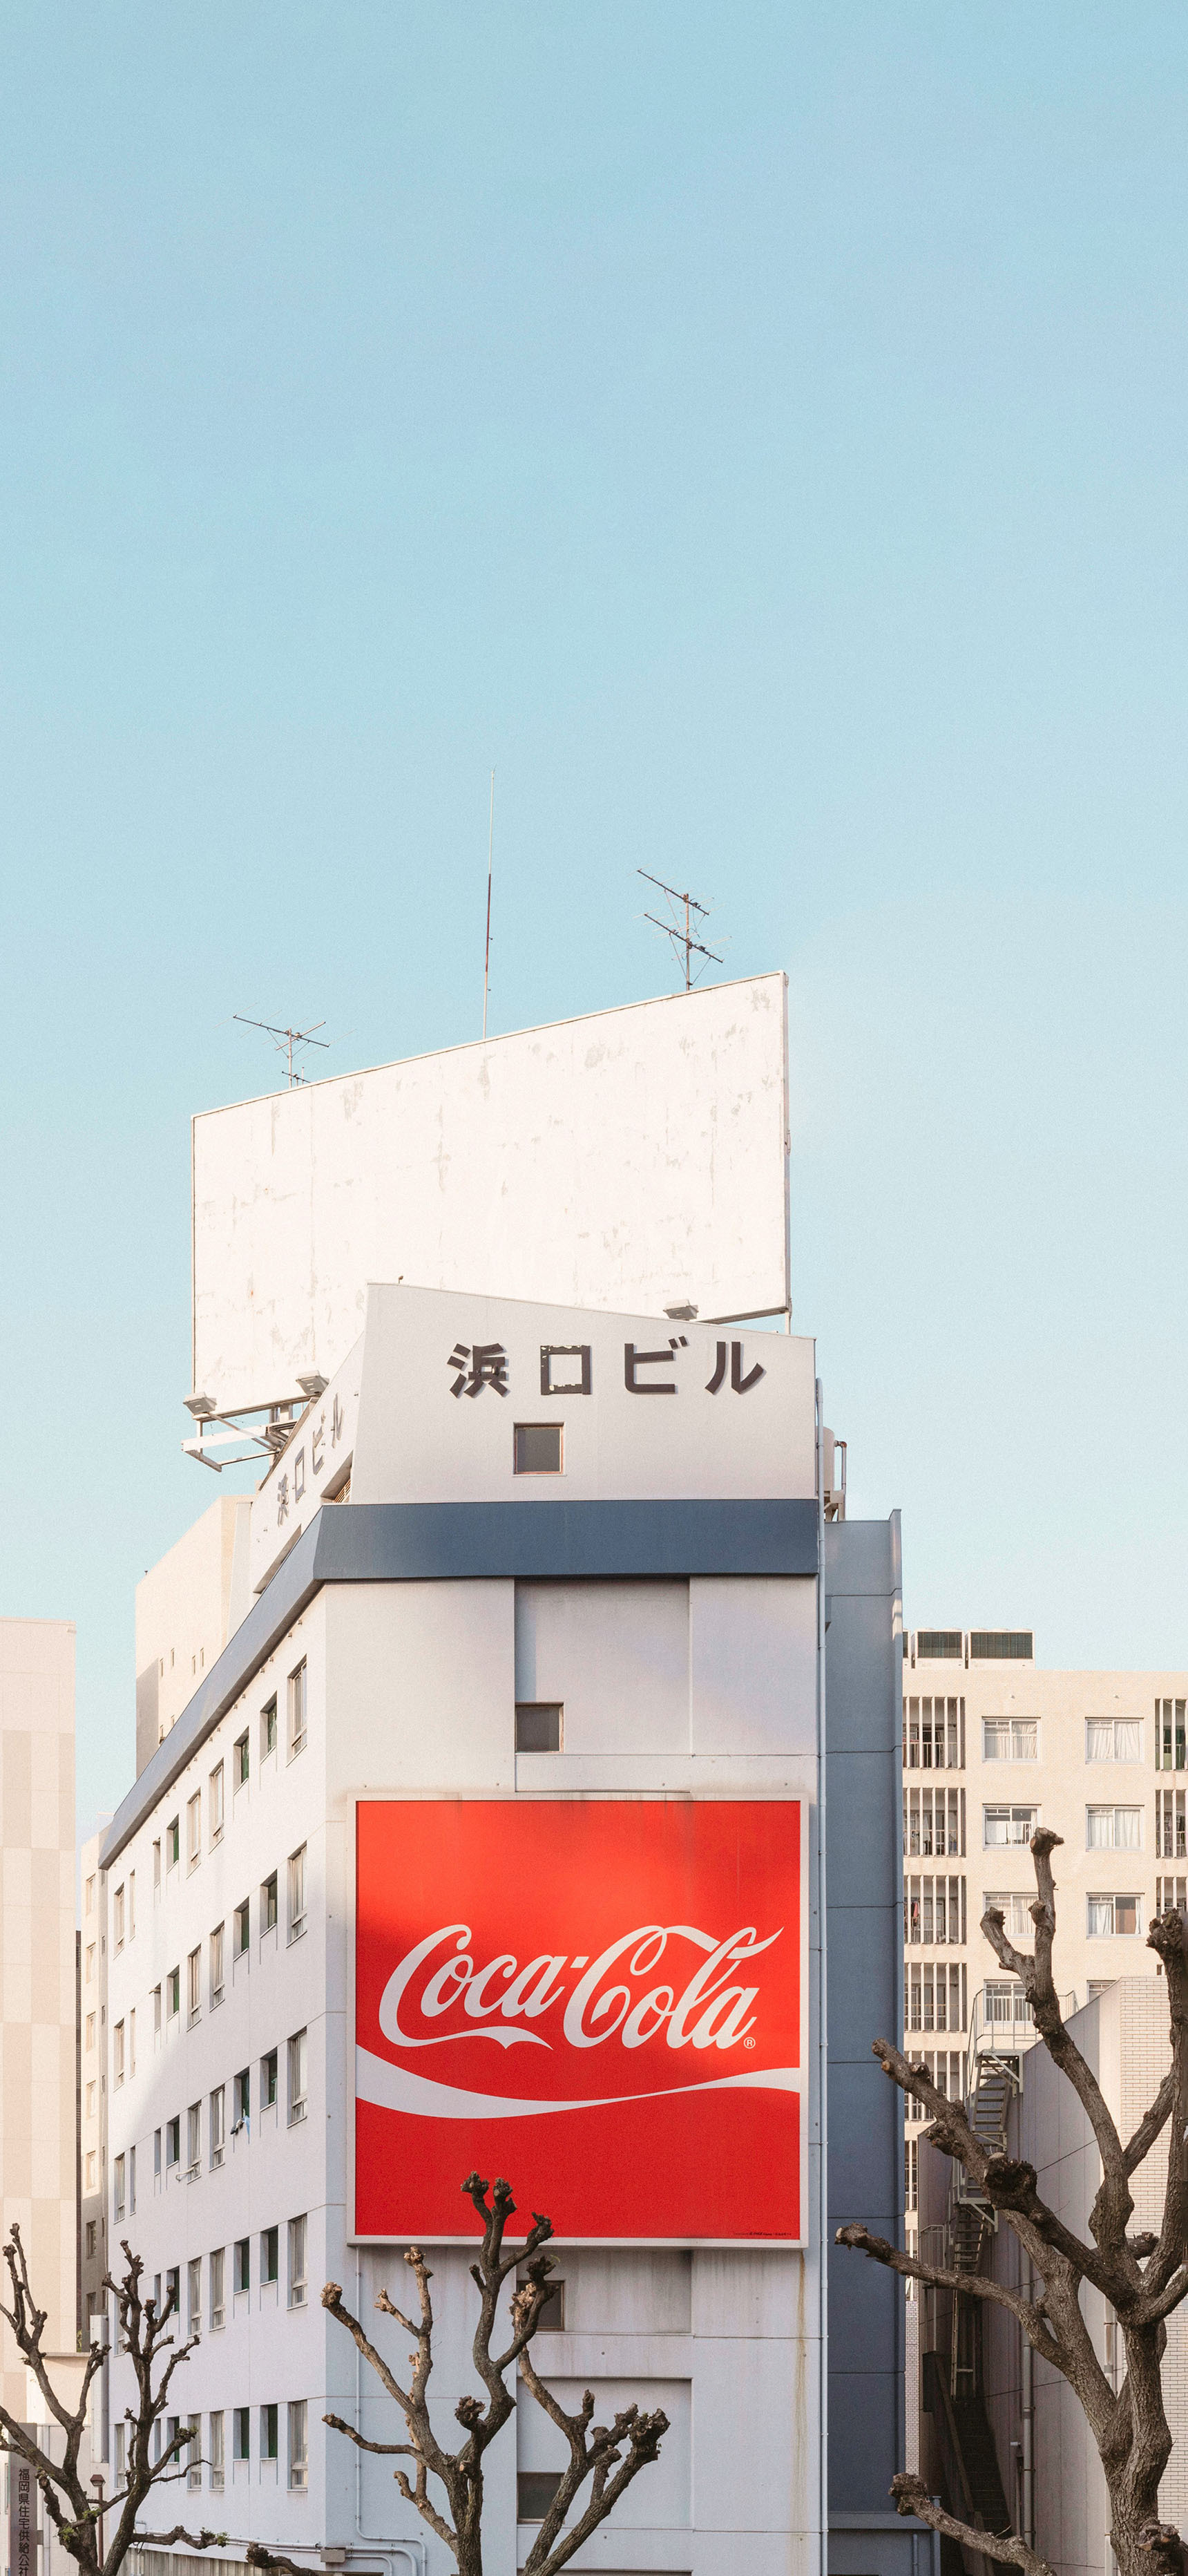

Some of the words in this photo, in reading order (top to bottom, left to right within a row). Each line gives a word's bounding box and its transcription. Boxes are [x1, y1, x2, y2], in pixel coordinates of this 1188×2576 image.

[447, 1336, 765, 1398] 浜口ビル
[379, 1924, 784, 2050] Coca-Cola
